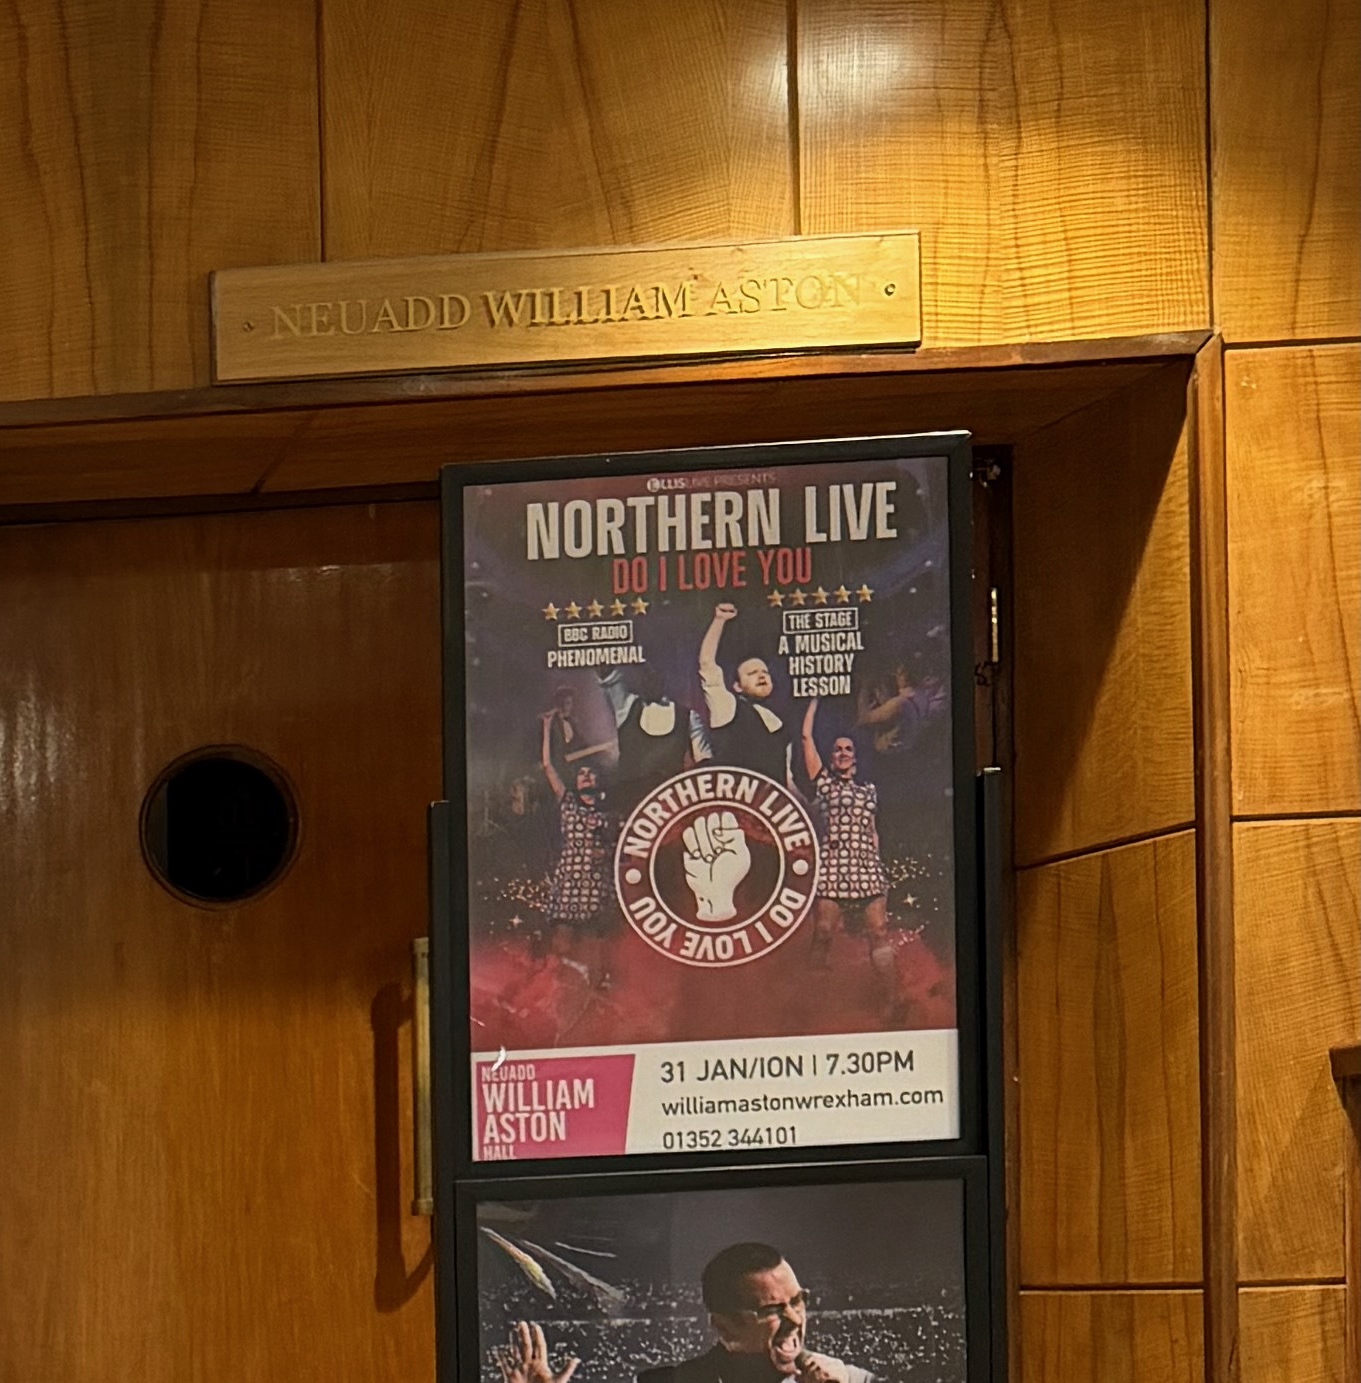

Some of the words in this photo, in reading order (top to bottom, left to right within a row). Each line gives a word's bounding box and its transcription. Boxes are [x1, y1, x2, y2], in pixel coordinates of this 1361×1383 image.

[270, 296, 470, 340] NEUADD
[479, 282, 696, 329] WILLIAM
[709, 271, 864, 315] ASTON
[526, 488, 780, 560] NORTHERN
[804, 481, 897, 543] LIVE
[613, 556, 648, 595] DO
[659, 555, 667, 591] I
[679, 551, 746, 591] LOVE
[760, 547, 812, 585] YOU
[564, 626, 588, 643] BBC
[592, 624, 628, 641] RADIO
[789, 613, 812, 629] THE
[816, 611, 852, 627] STAGE
[547, 645, 646, 668] PHENOMENAL
[779, 637, 789, 654] A
[795, 632, 864, 653] MUSICAL
[789, 654, 854, 675] HISTORY
[793, 675, 851, 697] LESSON
[623, 773, 759, 858] NORTHERN
[759, 791, 811, 851] LIVE
[629, 897, 677, 948] YOU
[770, 888, 807, 928] DO
[680, 931, 752, 961] LOVE
[755, 921, 773, 944] I
[660, 1061, 686, 1083] 31
[696, 1054, 804, 1082] JAN/ION
[826, 1051, 915, 1076] 7.30PM
[482, 1079, 594, 1113] WILLIAM
[662, 1087, 944, 1117] williamastonwrexham.com
[484, 1111, 566, 1144] ASTON
[662, 1129, 723, 1150] 01352
[728, 1126, 797, 1148] 344101
[483, 1145, 516, 1161] HALL
